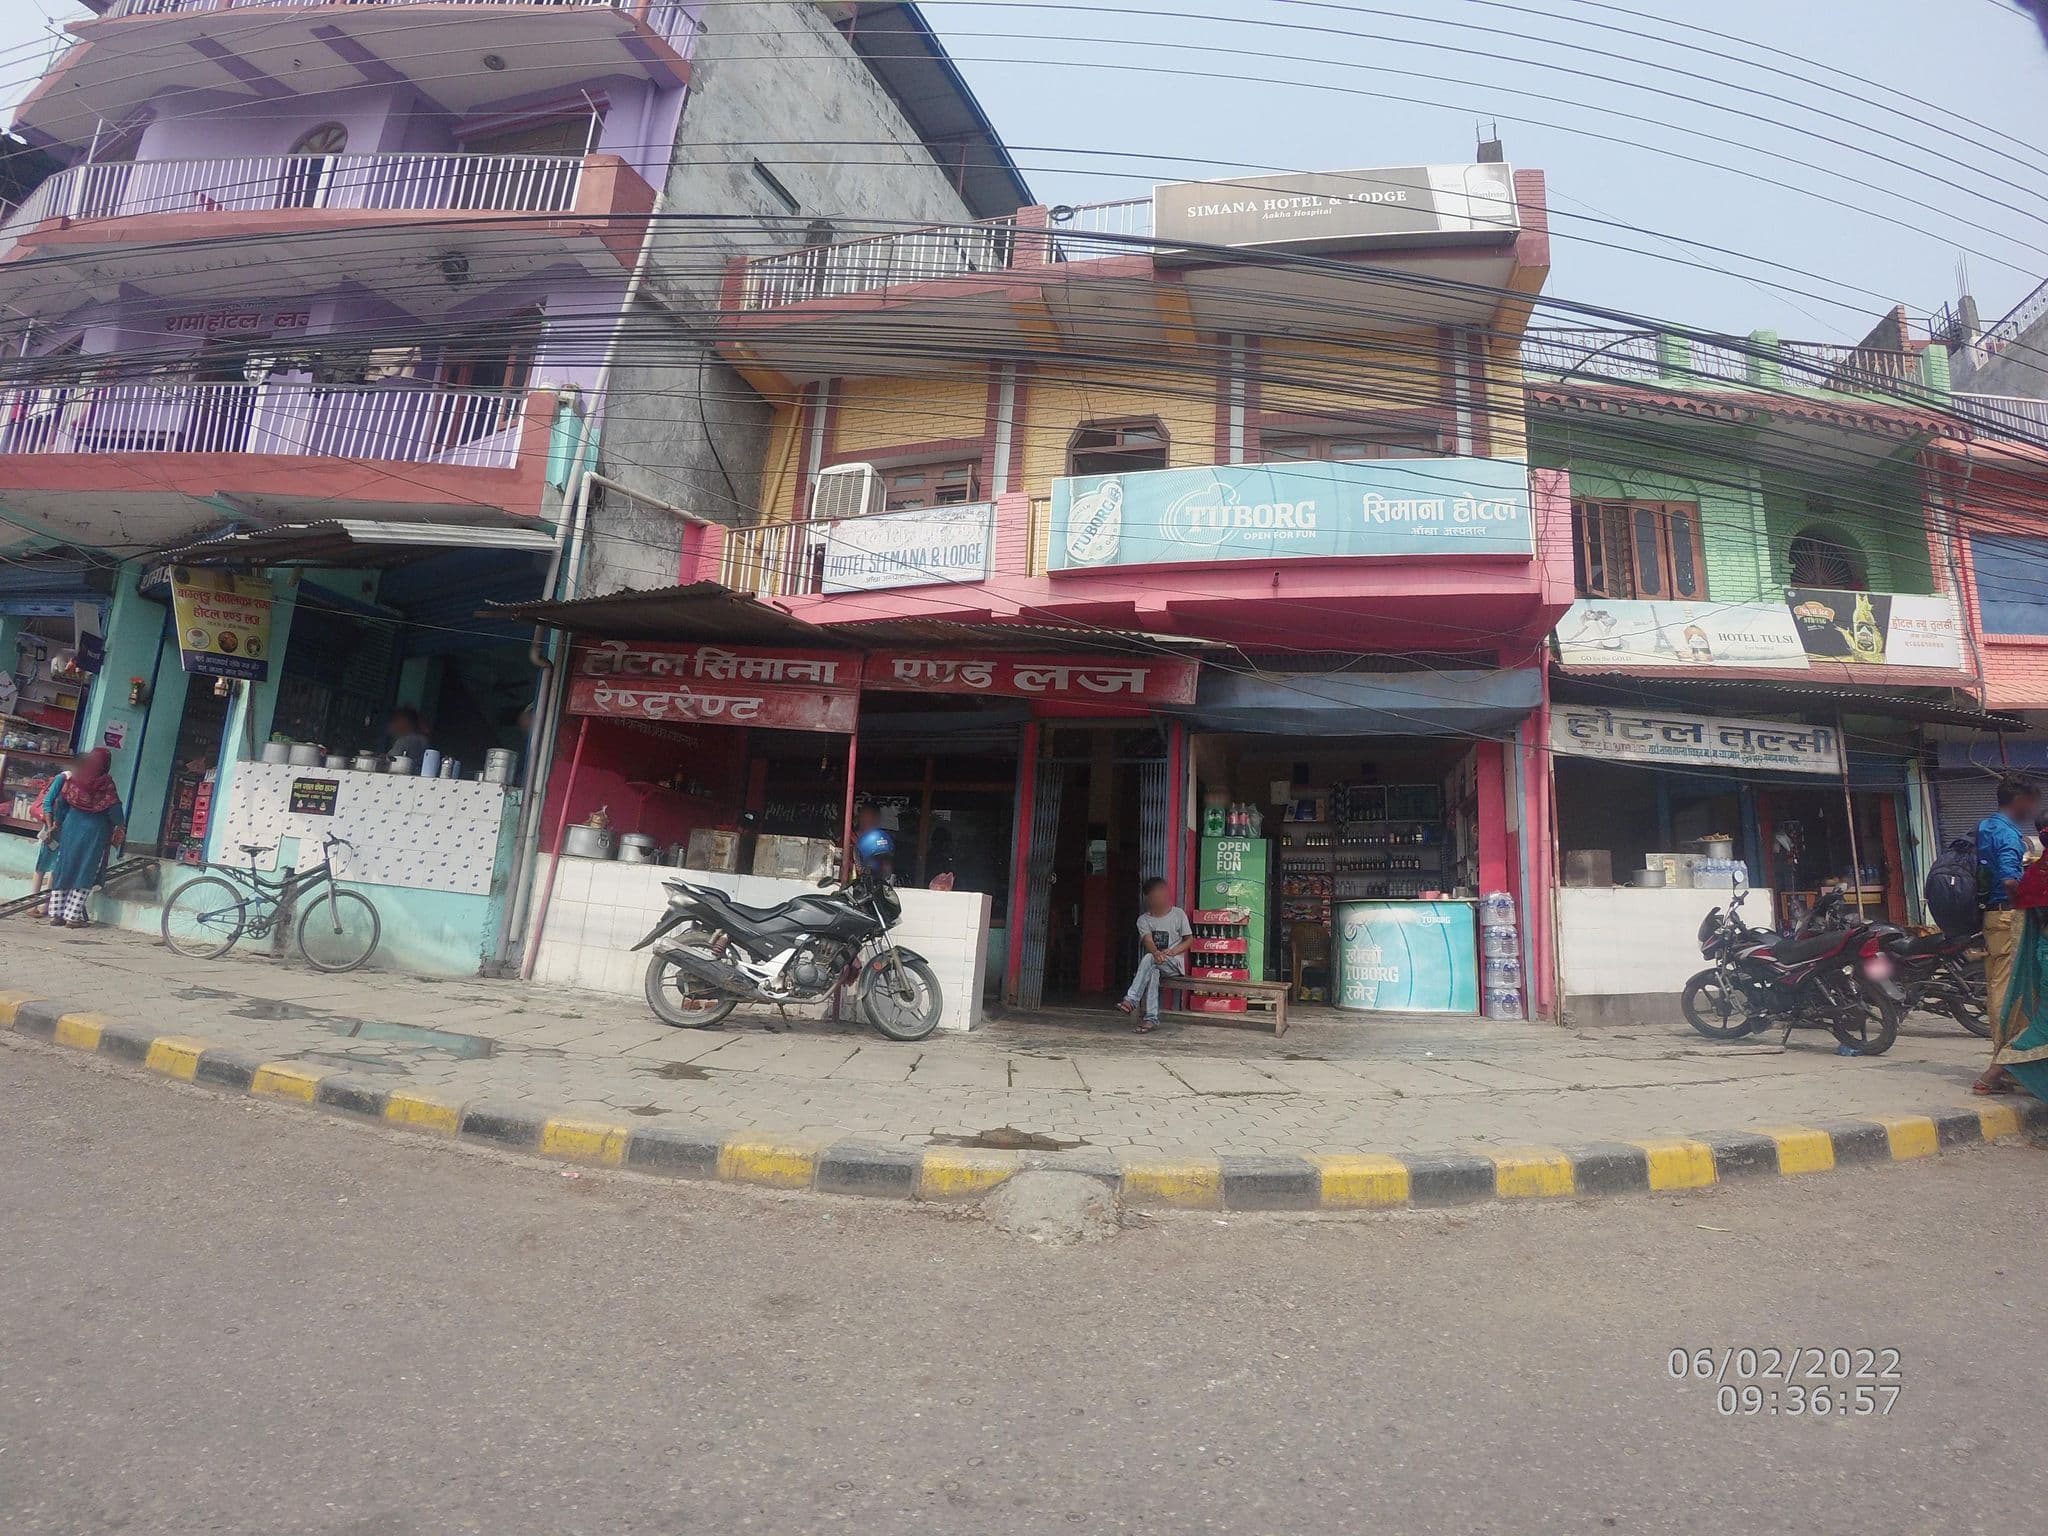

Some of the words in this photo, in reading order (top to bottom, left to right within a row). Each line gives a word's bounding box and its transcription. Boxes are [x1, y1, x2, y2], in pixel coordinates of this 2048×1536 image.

[1187, 201, 1258, 218] SIMANA
[1264, 196, 1322, 211] HOTEL
[1329, 196, 1342, 206] &
[1349, 191, 1407, 205] LODGE
[1185, 500, 1316, 533] TUBORG
[1362, 492, 1445, 524] सिमाना
[1452, 491, 1517, 523] होटल
[1071, 500, 1116, 554] TUBORG
[1244, 531, 1271, 541] OPEN
[1274, 531, 1293, 539] FOR
[1296, 530, 1316, 539] FUN
[829, 554, 865, 578] HOTEL
[943, 542, 983, 567] LODGE
[1718, 632, 1759, 643] HOTEL
[1760, 634, 1794, 645] TULSI
[582, 639, 689, 677] होटल
[692, 646, 840, 684] सिमाना
[891, 659, 998, 689] एण्ड
[1013, 664, 1151, 694] लज
[1566, 708, 1705, 743] होटल
[1217, 841, 1251, 852] OPEN
[1217, 851, 1241, 861] FOR
[1216, 861, 1242, 871] FUN
[1345, 966, 1399, 982] TUBORG
